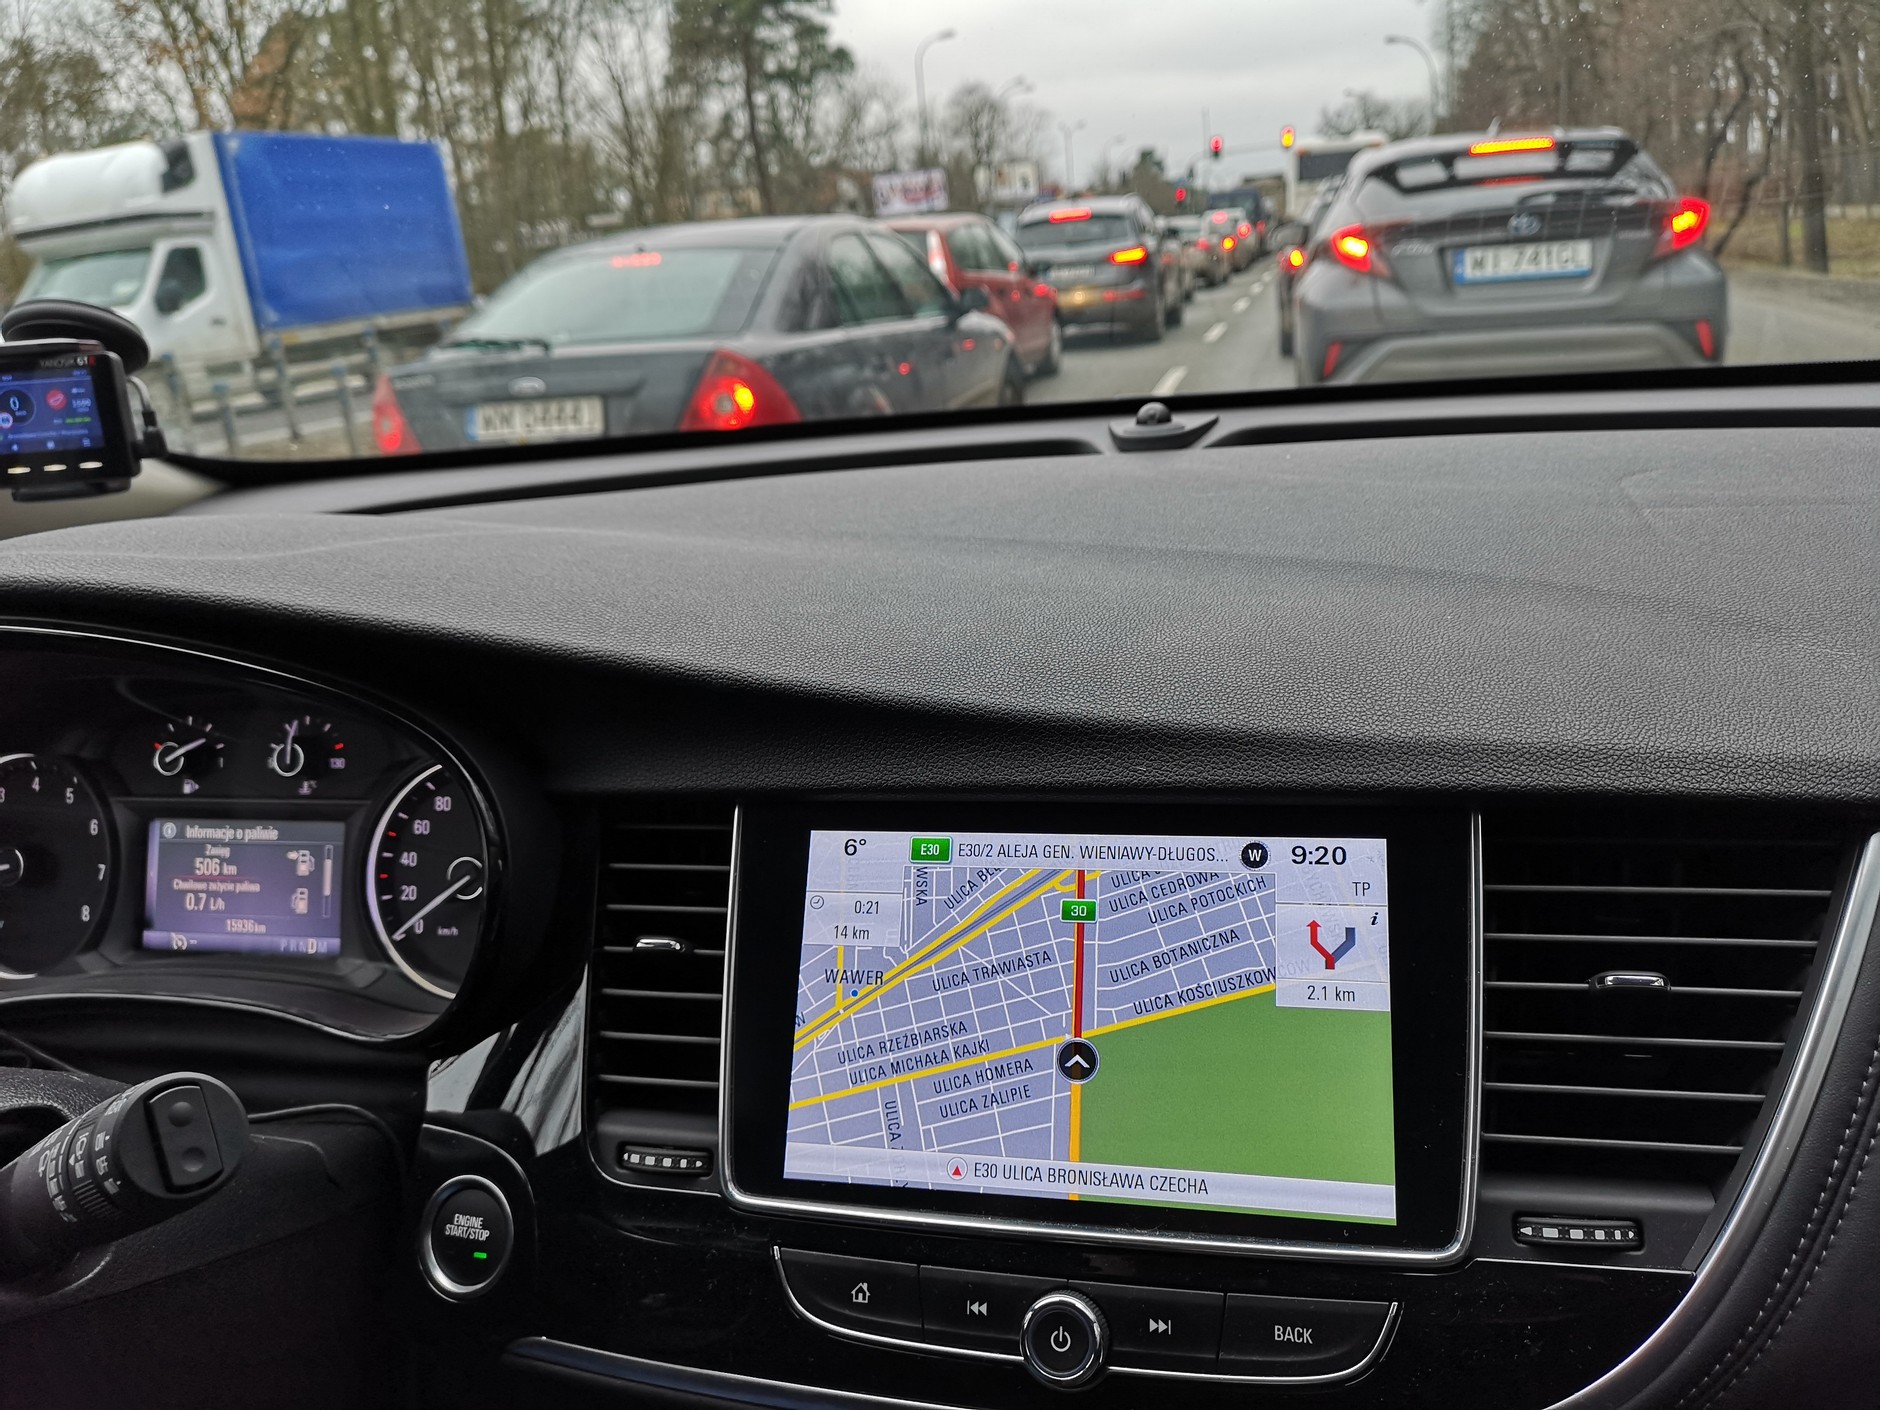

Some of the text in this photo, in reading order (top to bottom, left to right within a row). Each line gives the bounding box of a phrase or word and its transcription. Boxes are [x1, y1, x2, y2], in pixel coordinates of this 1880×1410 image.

[32, 777, 40, 792] 4
[66, 788, 74, 804] 5
[434, 796, 451, 812] 80
[90, 819, 99, 835] 6
[185, 824, 235, 842] Informacje
[236, 828, 243, 840] o
[413, 819, 430, 835] 60
[844, 838, 867, 856] 6°
[920, 843, 940, 856] E30
[958, 843, 993, 858] E30/2
[997, 844, 1038, 859] ALEJA
[1043, 845, 1074, 860] GEN.
[1248, 849, 1262, 862] W
[1291, 845, 1347, 866] 9:20
[195, 858, 237, 876] 506 km
[400, 852, 417, 868] 40
[97, 864, 106, 881] 7
[1111, 871, 1151, 888] ULICA
[400, 885, 417, 901] 20
[916, 866, 928, 906] WSKA
[943, 879, 979, 909] ULICA
[1109, 872, 1219, 912] ULICA CEDROWA
[1352, 881, 1371, 897] TP
[185, 892, 206, 911] 0.7
[854, 900, 879, 915] 0:21
[1148, 875, 1267, 924] ULICA POTOCKICH
[81, 905, 90, 922] 8
[1071, 905, 1087, 917] 30
[226, 918, 267, 934] 15936 km
[414, 919, 424, 934] 0
[437, 926, 459, 937] km/h
[834, 925, 870, 940] 14 km
[307, 938, 317, 954] D
[1110, 929, 1240, 983] ULICA BOTANICZNA
[824, 968, 884, 985] WAWER
[932, 950, 1052, 992] ULICA TRAWIASTA
[1307, 985, 1356, 1002] 2.1 km
[1133, 995, 1175, 1015] ULICA
[837, 1020, 968, 1065] ULICA RZEŹBIARSKA
[849, 1038, 991, 1086] ULICA MICHAŁA KAJKI
[933, 1058, 1034, 1095] ULICA HOMERA
[939, 1084, 1032, 1119] ULICA ZALIPIE
[884, 1100, 901, 1142] ULICA
[974, 1162, 1209, 1195] E30 ULICA BRONISŁAWA CZECHA
[454, 1214, 483, 1229] ENGINE
[445, 1224, 490, 1241] START/STOP
[1274, 1325, 1313, 1344] BACK
